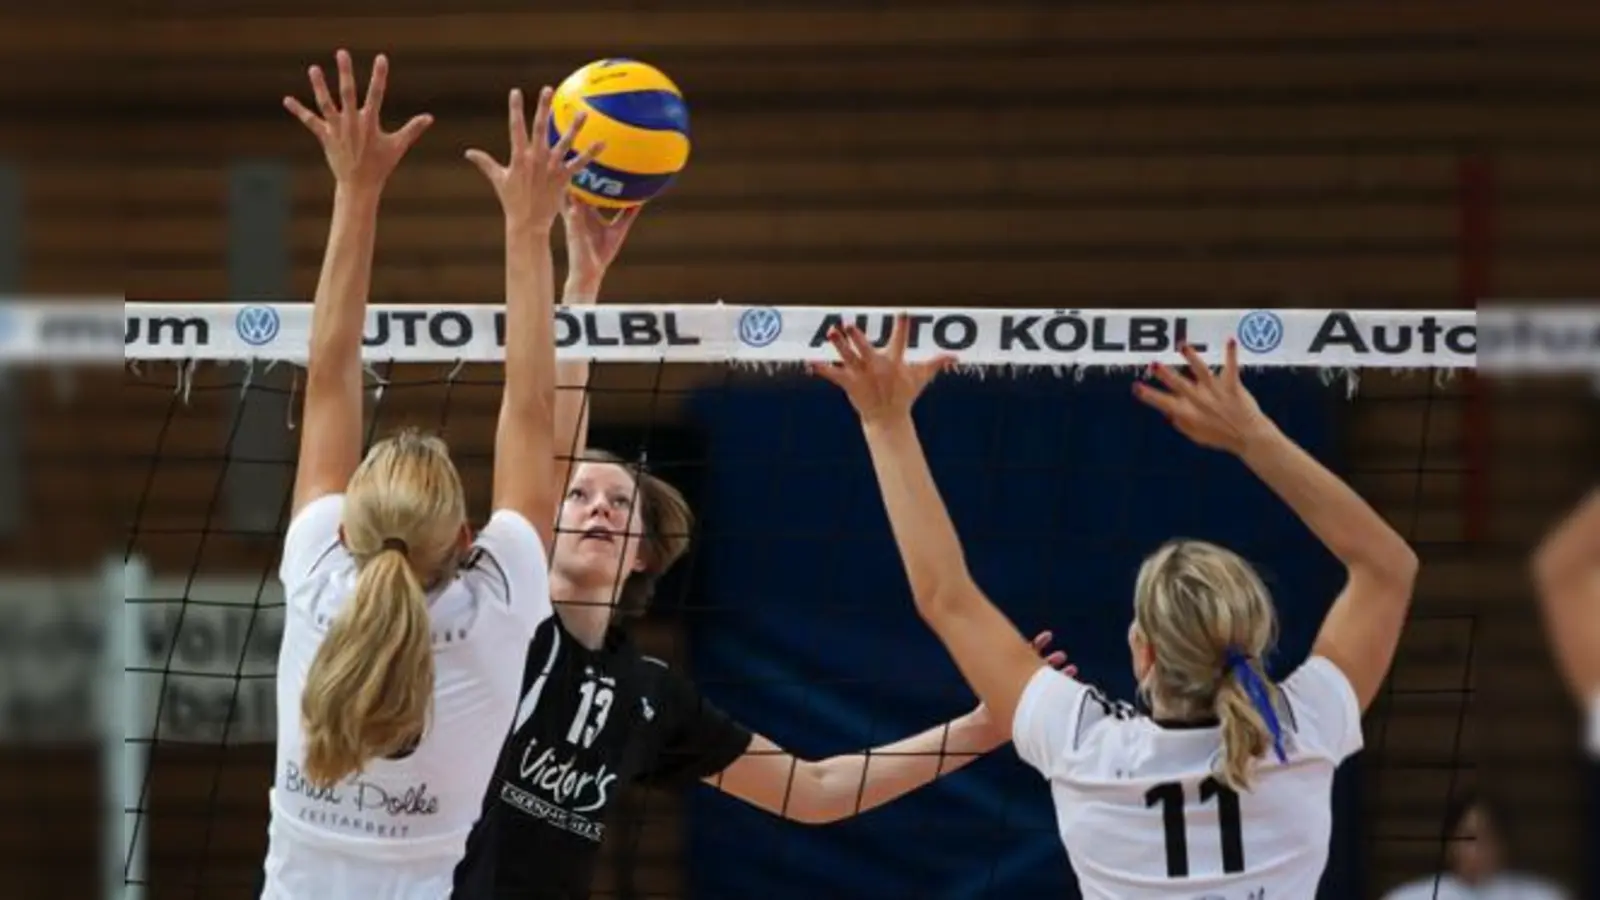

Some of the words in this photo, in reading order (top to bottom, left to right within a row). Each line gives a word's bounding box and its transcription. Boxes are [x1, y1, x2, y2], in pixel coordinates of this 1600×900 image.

[362, 311, 473, 348] UTO
[494, 306, 700, 348] ÖLBL
[1000, 309, 1208, 353] KÖLBL
[566, 680, 614, 748] 13
[1145, 777, 1245, 877] 11
